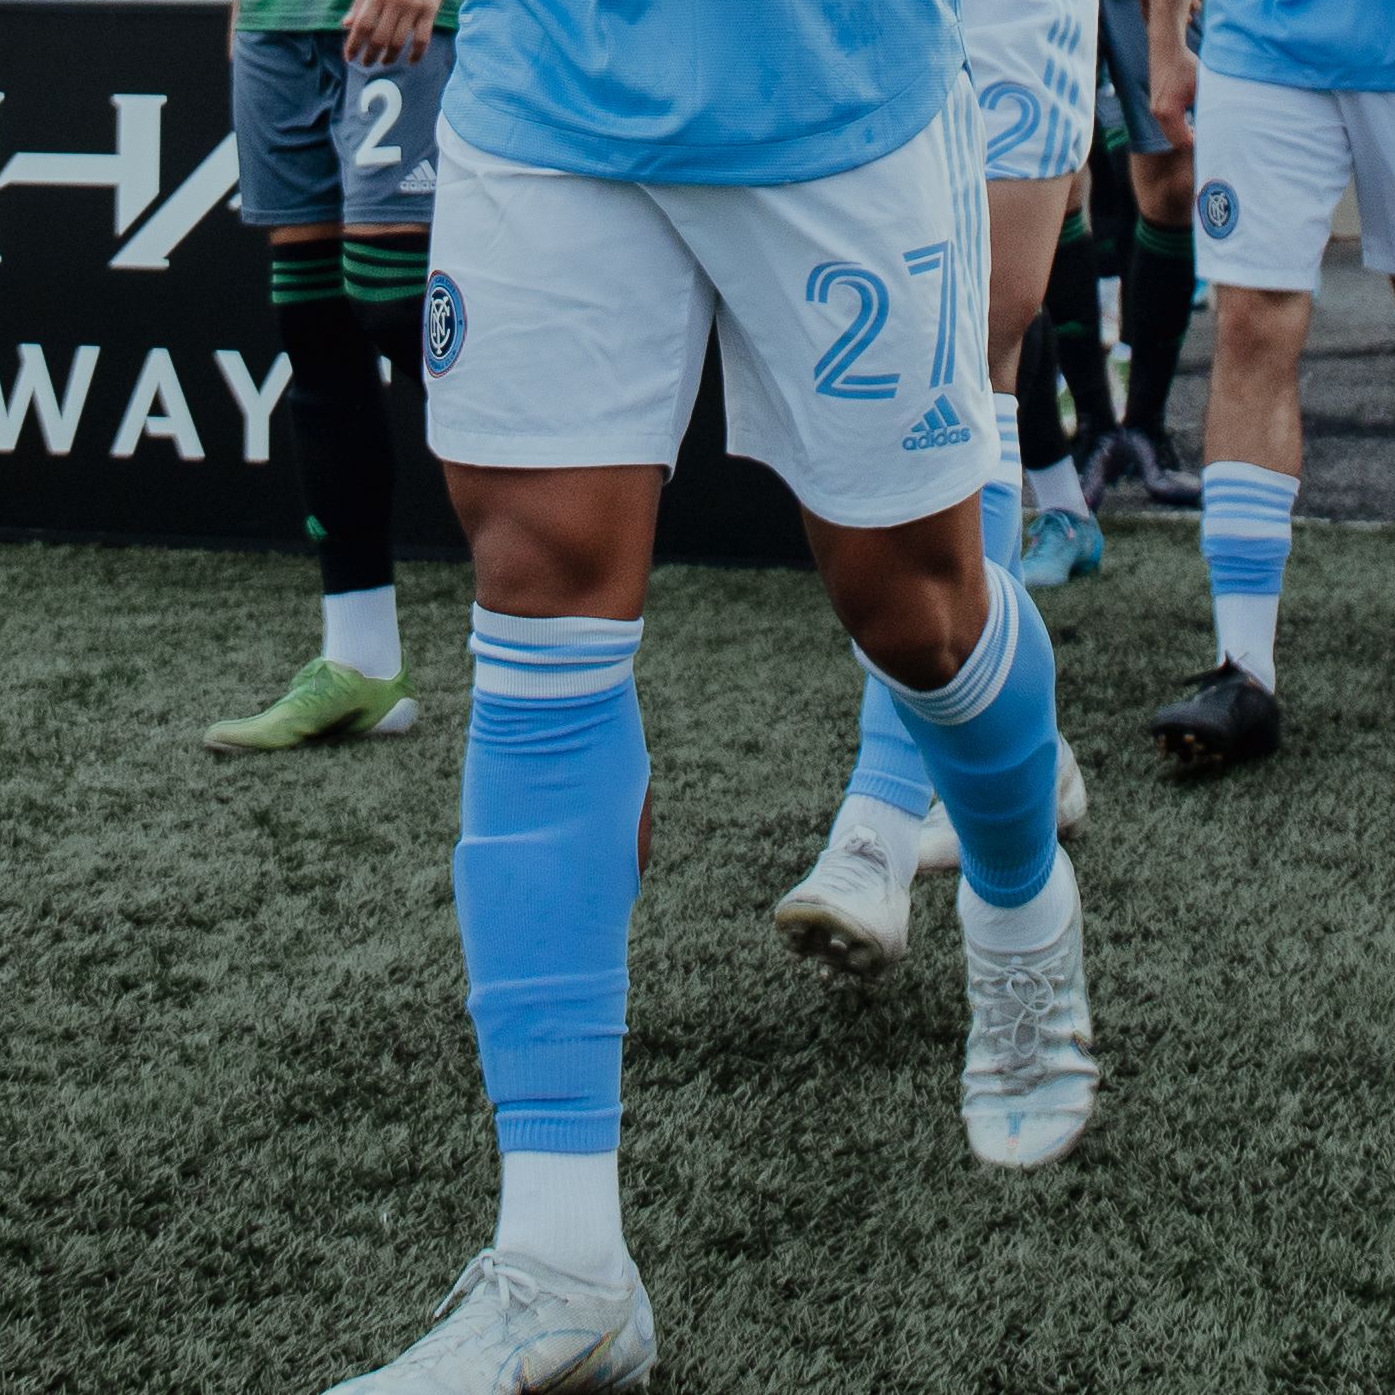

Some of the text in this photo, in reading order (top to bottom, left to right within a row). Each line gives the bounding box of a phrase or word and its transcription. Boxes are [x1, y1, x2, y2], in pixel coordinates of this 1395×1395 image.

[355, 78, 403, 166] 2
[805, 240, 957, 400] 27
[902, 426, 972, 452] adidas
